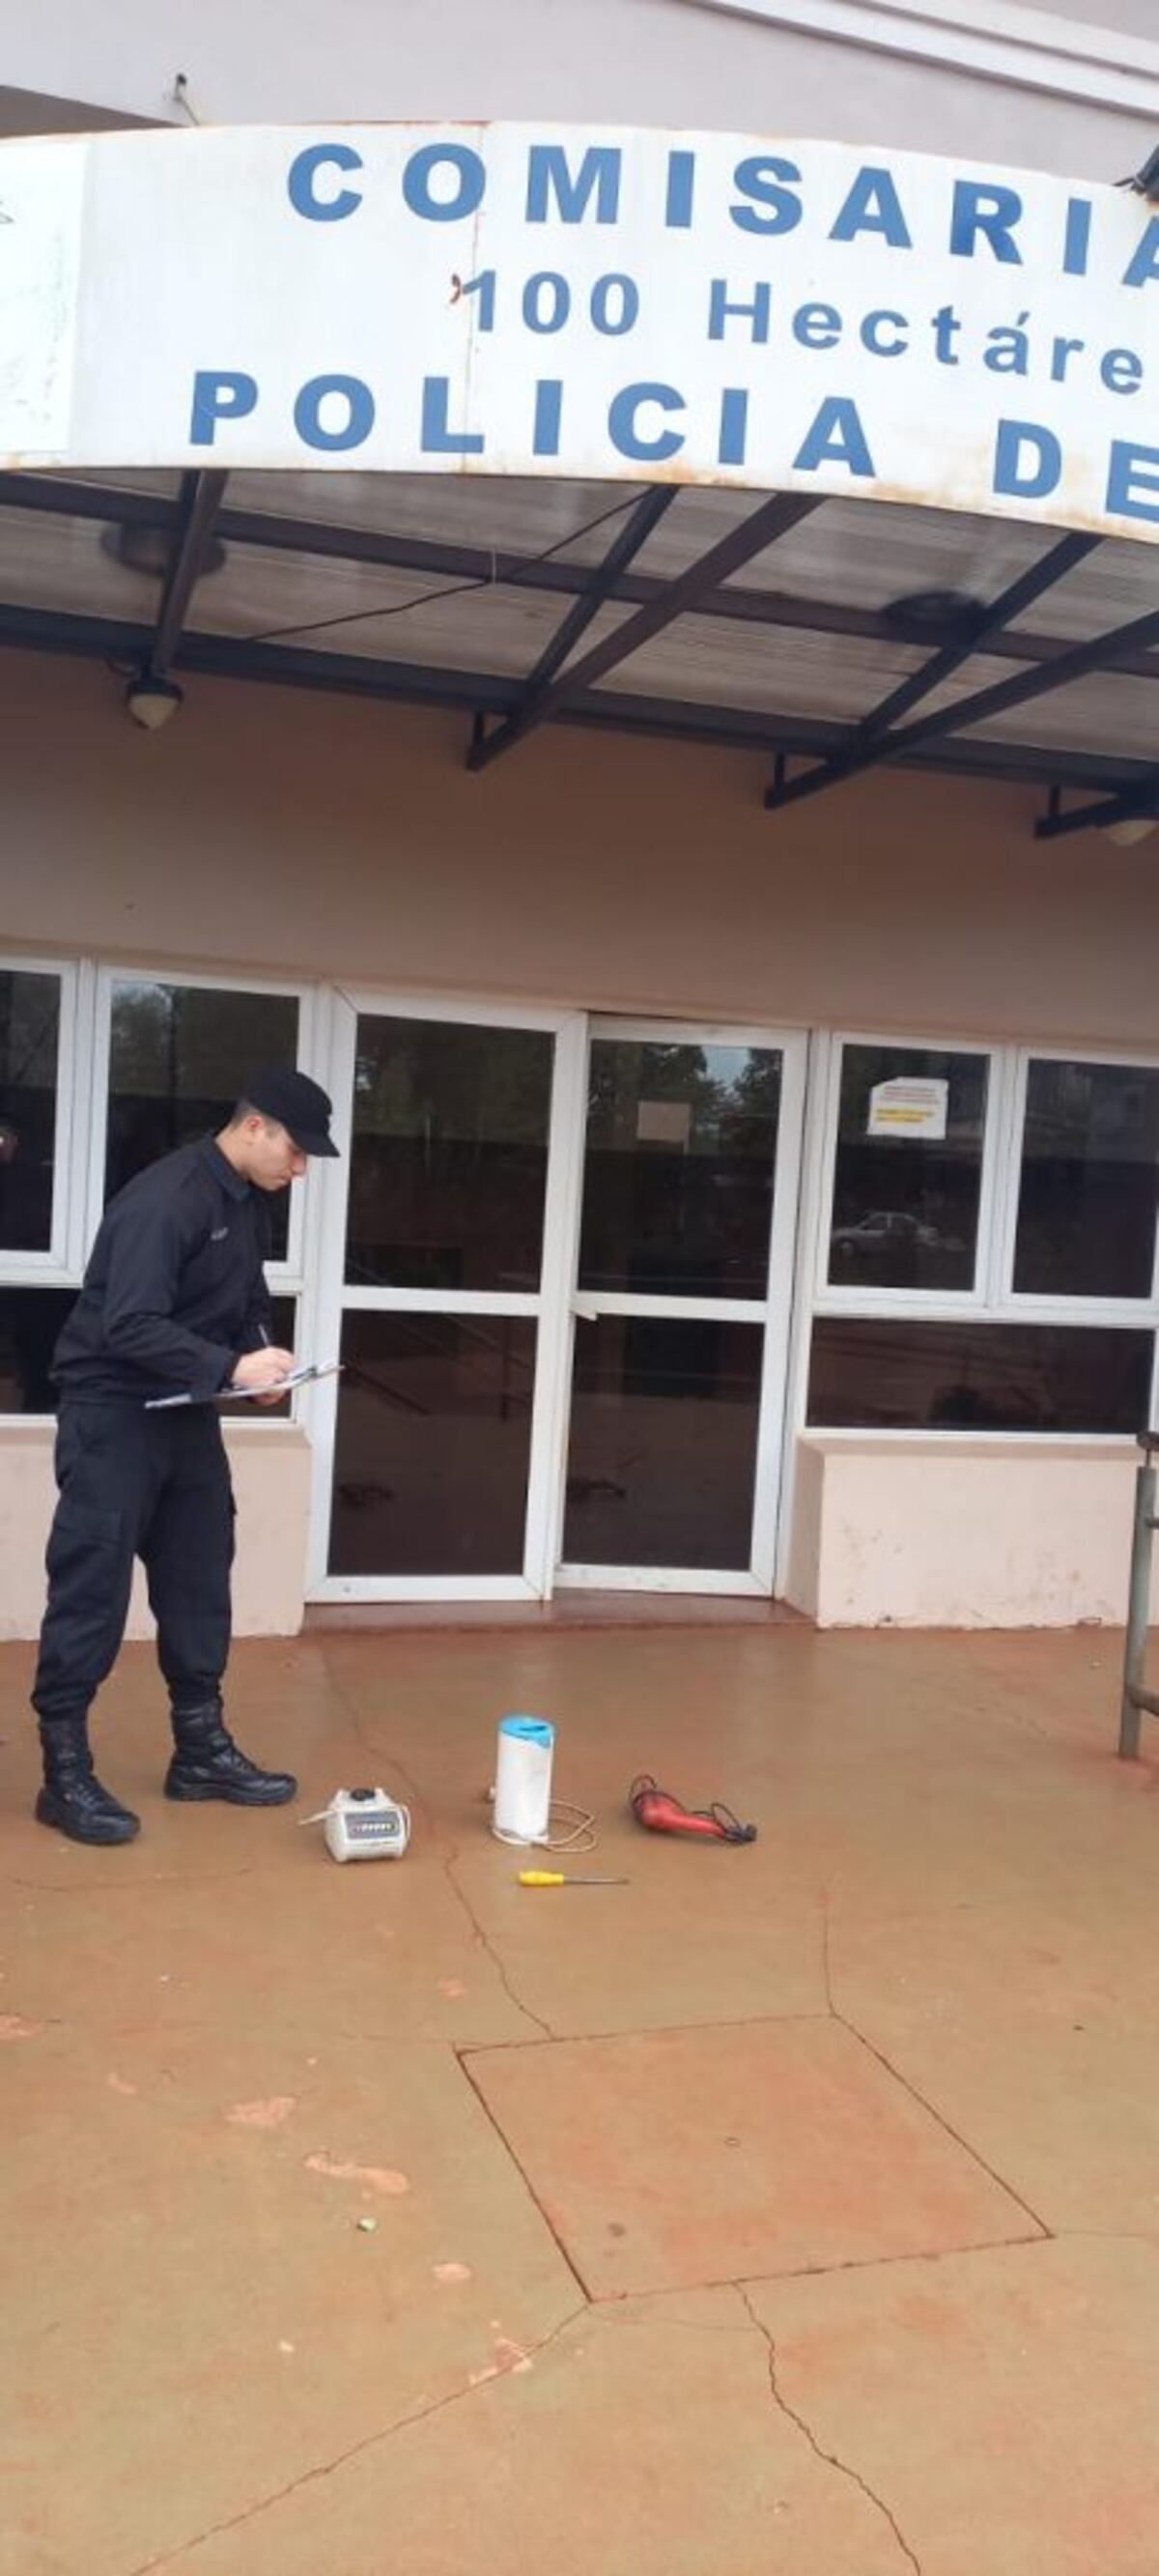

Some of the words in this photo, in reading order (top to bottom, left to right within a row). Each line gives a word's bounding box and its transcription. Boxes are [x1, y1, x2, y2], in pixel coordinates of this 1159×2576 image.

[462, 270, 639, 335] 100
[708, 279, 1143, 395] Hectáre
[189, 370, 876, 477] POLICIA
[993, 419, 1159, 523] DE
